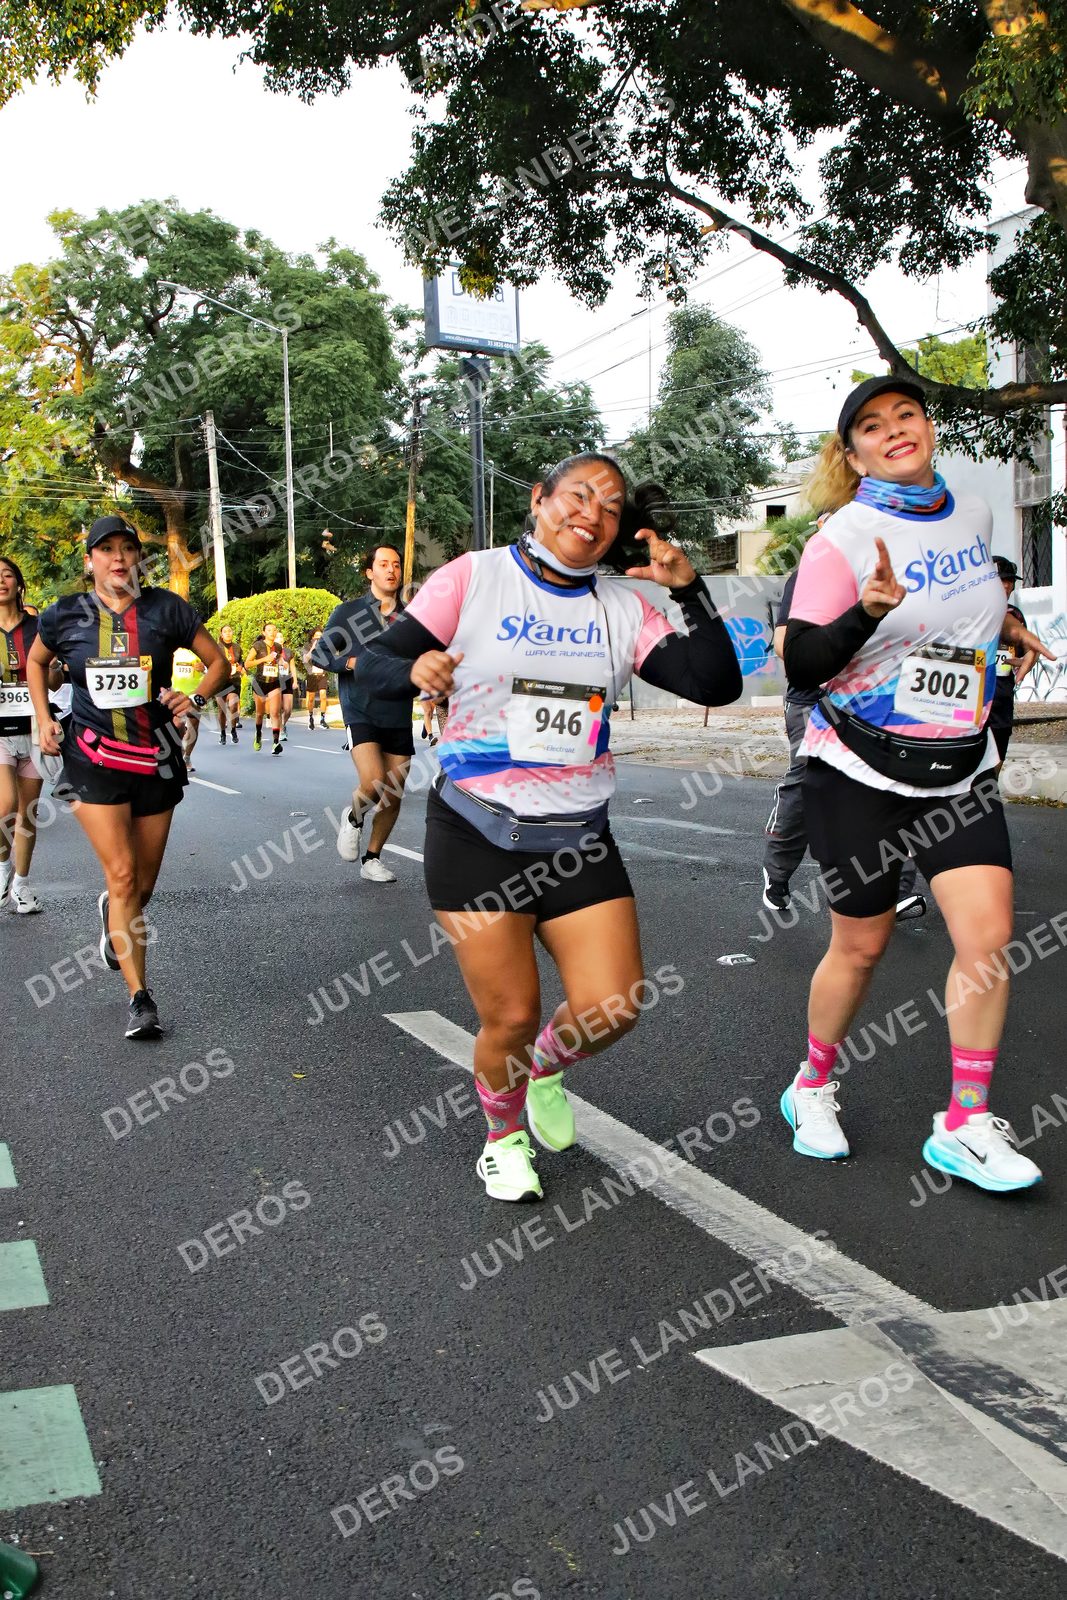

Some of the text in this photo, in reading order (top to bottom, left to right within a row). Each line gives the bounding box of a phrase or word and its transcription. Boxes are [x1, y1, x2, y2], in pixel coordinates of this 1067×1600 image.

[941, 583, 967, 601] WAVE
[559, 650, 605, 658] RUNNERS
[95, 674, 139, 691] 3738
[910, 667, 970, 700] 3002
[0, 692, 29, 703] 3965
[535, 707, 582, 736] 946
